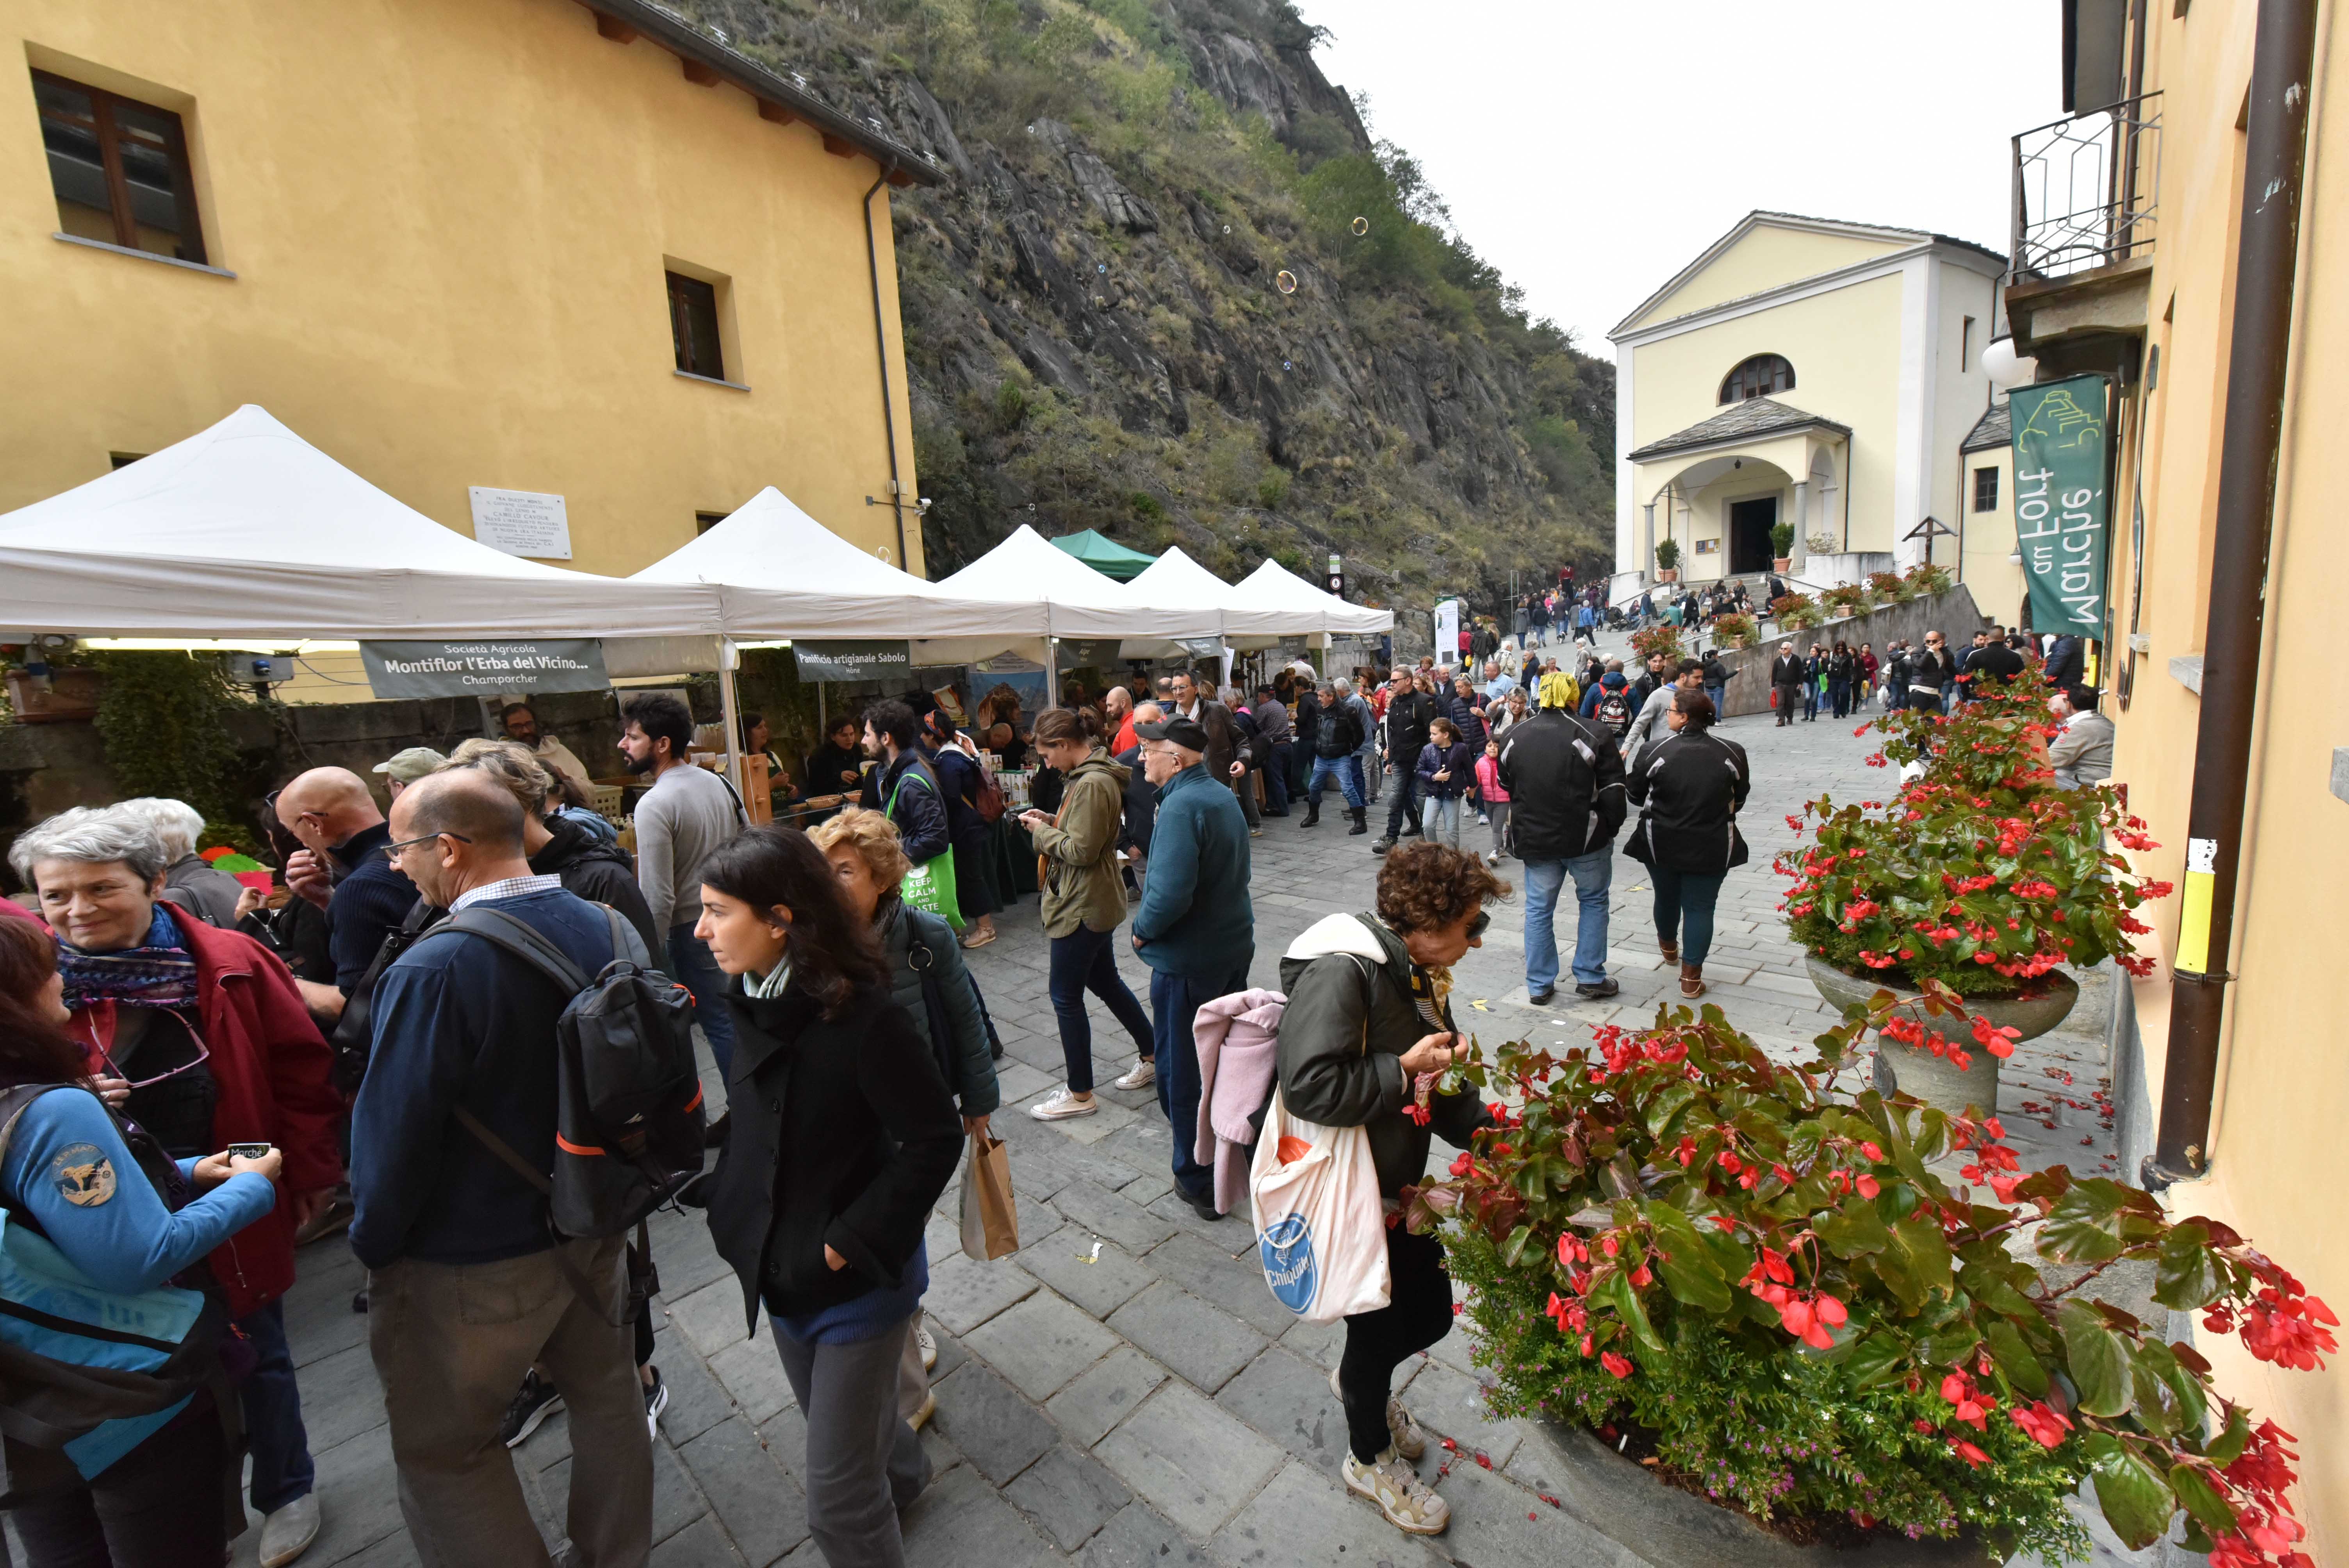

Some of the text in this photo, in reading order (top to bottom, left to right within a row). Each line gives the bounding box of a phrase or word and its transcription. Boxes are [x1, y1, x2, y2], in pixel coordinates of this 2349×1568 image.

[445, 645, 536, 656] Società Agricola
[385, 658, 462, 673] Montiflor
[513, 657, 535, 669] del
[538, 656, 588, 669] Vicino...
[799, 652, 906, 666] Panificio artigianale Sabolo
[462, 674, 537, 686] Champorcher
[909, 877, 931, 888] KEEP
[908, 887, 936, 898] CALM
[1267, 1255, 1309, 1286] Chiquita
